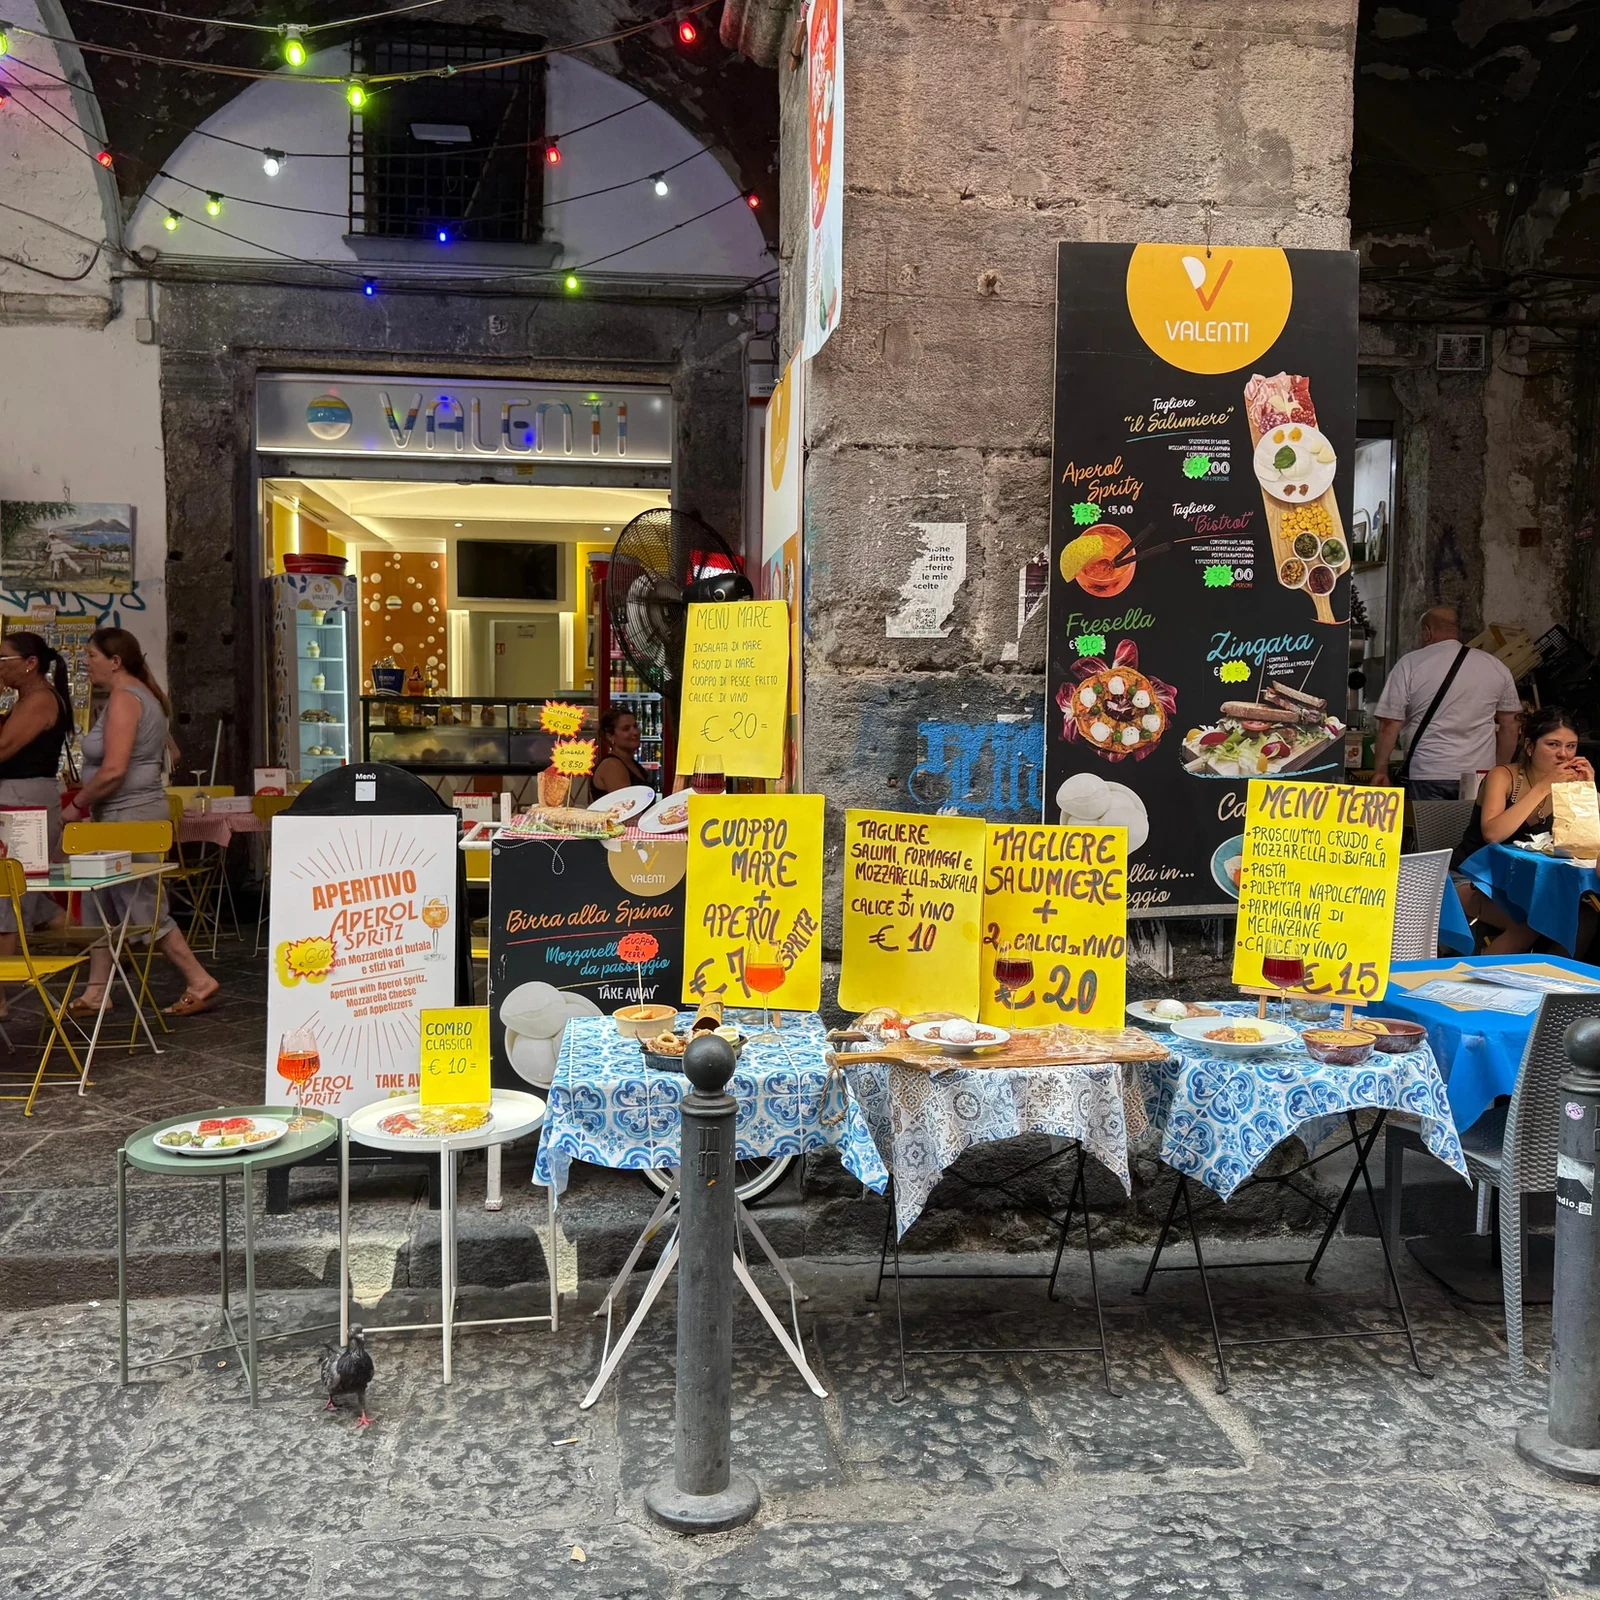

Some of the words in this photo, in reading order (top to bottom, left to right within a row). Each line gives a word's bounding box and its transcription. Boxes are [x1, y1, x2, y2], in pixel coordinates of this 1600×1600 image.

[1165, 320, 1249, 342] VALENTI
[1152, 397, 1196, 413] Tagliere
[380, 391, 627, 457] VALENTI
[1062, 456, 1123, 486] Aperol
[1088, 476, 1144, 504] Spritz
[1172, 502, 1216, 519] Tagliere
[737, 606, 772, 629] MARE
[1066, 607, 1156, 637] Fresella
[693, 642, 728, 653] INSALATA
[732, 641, 739, 651] DI
[742, 640, 762, 650] MARE
[1206, 630, 1315, 666] Zingara
[692, 659, 721, 670] RISOTTO
[724, 659, 733, 668] DI
[736, 657, 756, 669] MARE
[690, 676, 717, 687] CUOPPO
[720, 676, 727, 686] DI
[731, 676, 750, 687] PESCE
[755, 675, 778, 686] FRITTO
[688, 693, 714, 703] CALICE
[719, 693, 727, 703] DI
[730, 692, 748, 703] VINO
[700, 715, 724, 742] €
[1336, 786, 1400, 833] TERRA
[700, 817, 788, 850] CUOPPO
[857, 819, 930, 845] TAGLIERE
[1252, 825, 1321, 846] PROSCIUTTO
[1328, 830, 1369, 850] CRUDO
[1375, 838, 1384, 851] E
[904, 846, 962, 871] FORMAGGI
[964, 858, 973, 871] E
[993, 827, 1116, 866] TAGLIERE
[1252, 842, 1326, 864] MOZZARELLA
[1329, 852, 1340, 864] DI
[1343, 850, 1386, 868] BUFALA
[631, 874, 666, 884] VALENTI
[732, 848, 798, 889] MARE
[855, 862, 928, 888] MOZZARELLA
[929, 879, 940, 889] DI
[940, 873, 978, 894] BUFALA
[1251, 862, 1286, 879] PASTA
[312, 869, 417, 911] APERITIVO
[984, 866, 1123, 906] SALUMIERE
[1250, 880, 1301, 898] POLPETTA
[1309, 882, 1386, 908] NAPOLETANA
[330, 900, 419, 938] APEROL
[506, 910, 565, 933] Birra
[567, 903, 610, 925] alla
[615, 899, 674, 926] Spina
[851, 898, 894, 916] CALICE
[898, 901, 914, 917] DI
[920, 901, 954, 921] VINO
[1247, 899, 1321, 922] PARMIGIANA
[1328, 910, 1344, 922] DI
[703, 903, 782, 946] APEROL
[869, 925, 899, 951] €
[907, 922, 937, 952] 10
[1247, 916, 1322, 939] MELANZANE
[335, 957, 346, 968] on
[348, 947, 393, 965] Mozzarella
[395, 945, 403, 956] di
[405, 940, 432, 954] bufala
[1014, 933, 1067, 954] CALICI
[1067, 944, 1080, 956] DI
[1083, 934, 1125, 959] VINO
[1313, 941, 1348, 960] VINO
[361, 966, 367, 974] e
[368, 960, 387, 974] sfizi
[389, 957, 405, 970] vari
[580, 961, 599, 976] da
[689, 957, 728, 997] €
[727, 946, 752, 999] 7
[330, 986, 357, 1000] Aperitif
[359, 983, 376, 994] with
[377, 978, 402, 991] Aperol
[1042, 964, 1098, 1015] 20
[1302, 963, 1333, 995] €
[1335, 961, 1380, 998] 15
[346, 993, 388, 1008] Mozzarella
[389, 987, 416, 999] Cheese
[598, 984, 623, 999] TAKE
[625, 984, 659, 1002] AWAY
[353, 1007, 368, 1018] and
[369, 998, 414, 1015] Appetizzers
[426, 1021, 473, 1036] COMBO
[426, 1038, 473, 1051] CLASSICA
[427, 1058, 441, 1075] €
[286, 1074, 354, 1096] APEROL
[375, 1074, 404, 1088] TAKE
